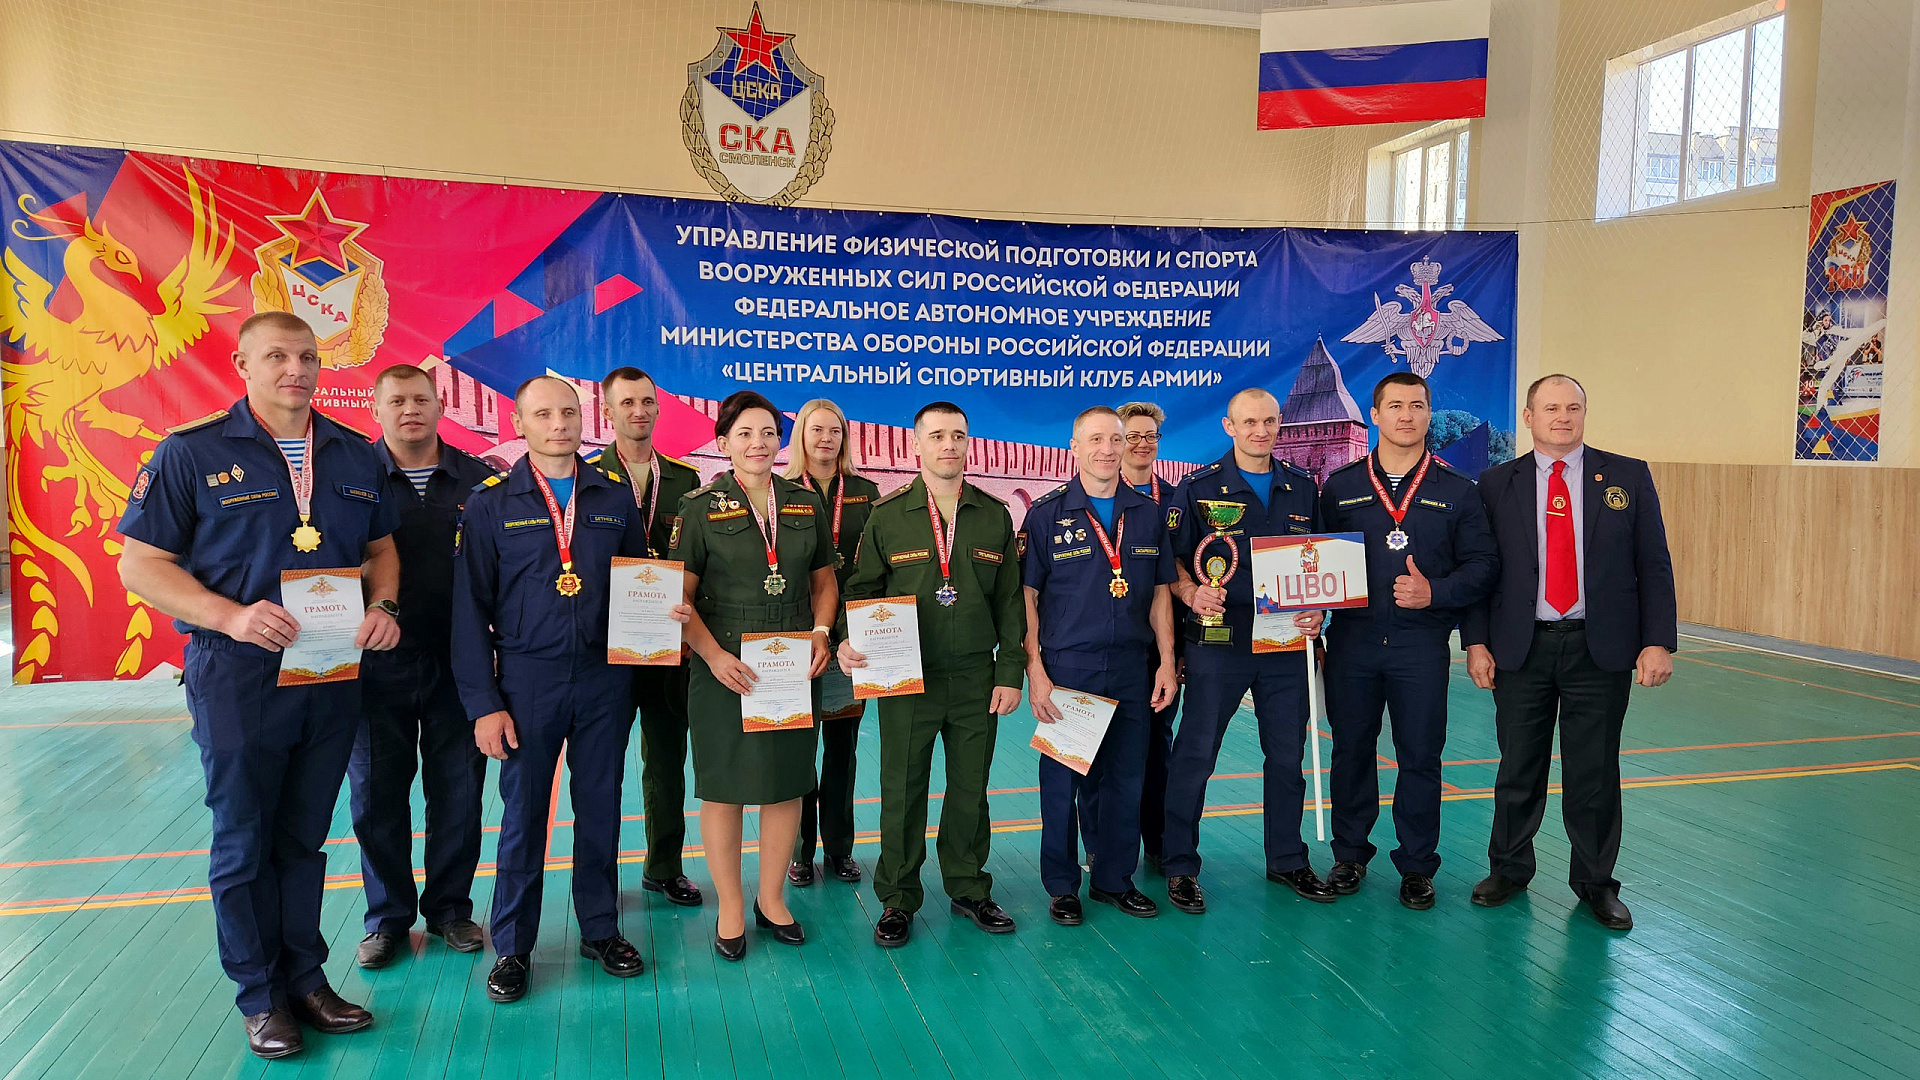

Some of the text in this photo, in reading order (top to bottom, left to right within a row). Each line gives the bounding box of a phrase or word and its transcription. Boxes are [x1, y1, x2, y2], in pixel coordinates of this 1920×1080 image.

[733, 79, 782, 100] ЦСКА
[718, 123, 796, 155] СКА
[719, 153, 797, 169] СМОЛЕНСК
[675, 224, 1258, 269] УПРАВЛЕНИЕ ФИЗИЧЕСКОЙ ПОДГОТОВКИ И СПОРТА
[699, 260, 1240, 300] ВООРУЖЕННЫХ СИЛ РОССИЙСКОЙ ФЕДЕРАЦИИ
[1827, 263, 1865, 293] 100
[292, 284, 348, 323] ЦСКА
[734, 296, 1212, 329] ФЕДЕРАЛЬНОЕ АВТОНОМНОЕ УЧРЕЖДЕНИЕ
[660, 325, 1270, 359] МИНИСТЕРСТВА ОБОРОНЫ РОССИЙСКОЙ ФЕДЕРАЦИИ
[721, 361, 1223, 388] «ЦЕНТРАЛЬНЫЙ СПОРТИВНЫЙ КЛУБ АРМИИ»
[310, 398, 369, 409] ТИВНЫЙ
[313, 386, 375, 397] РАЛЬНЫЙ
[628, 590, 667, 599] ГРАМОТА
[1285, 572, 1337, 603] ЦВО
[304, 604, 348, 613] ГРАМОТА
[864, 626, 903, 636] ГРАМОТА
[757, 660, 796, 668] ГРАМОТА
[1062, 703, 1096, 719] ГРАМОТА
